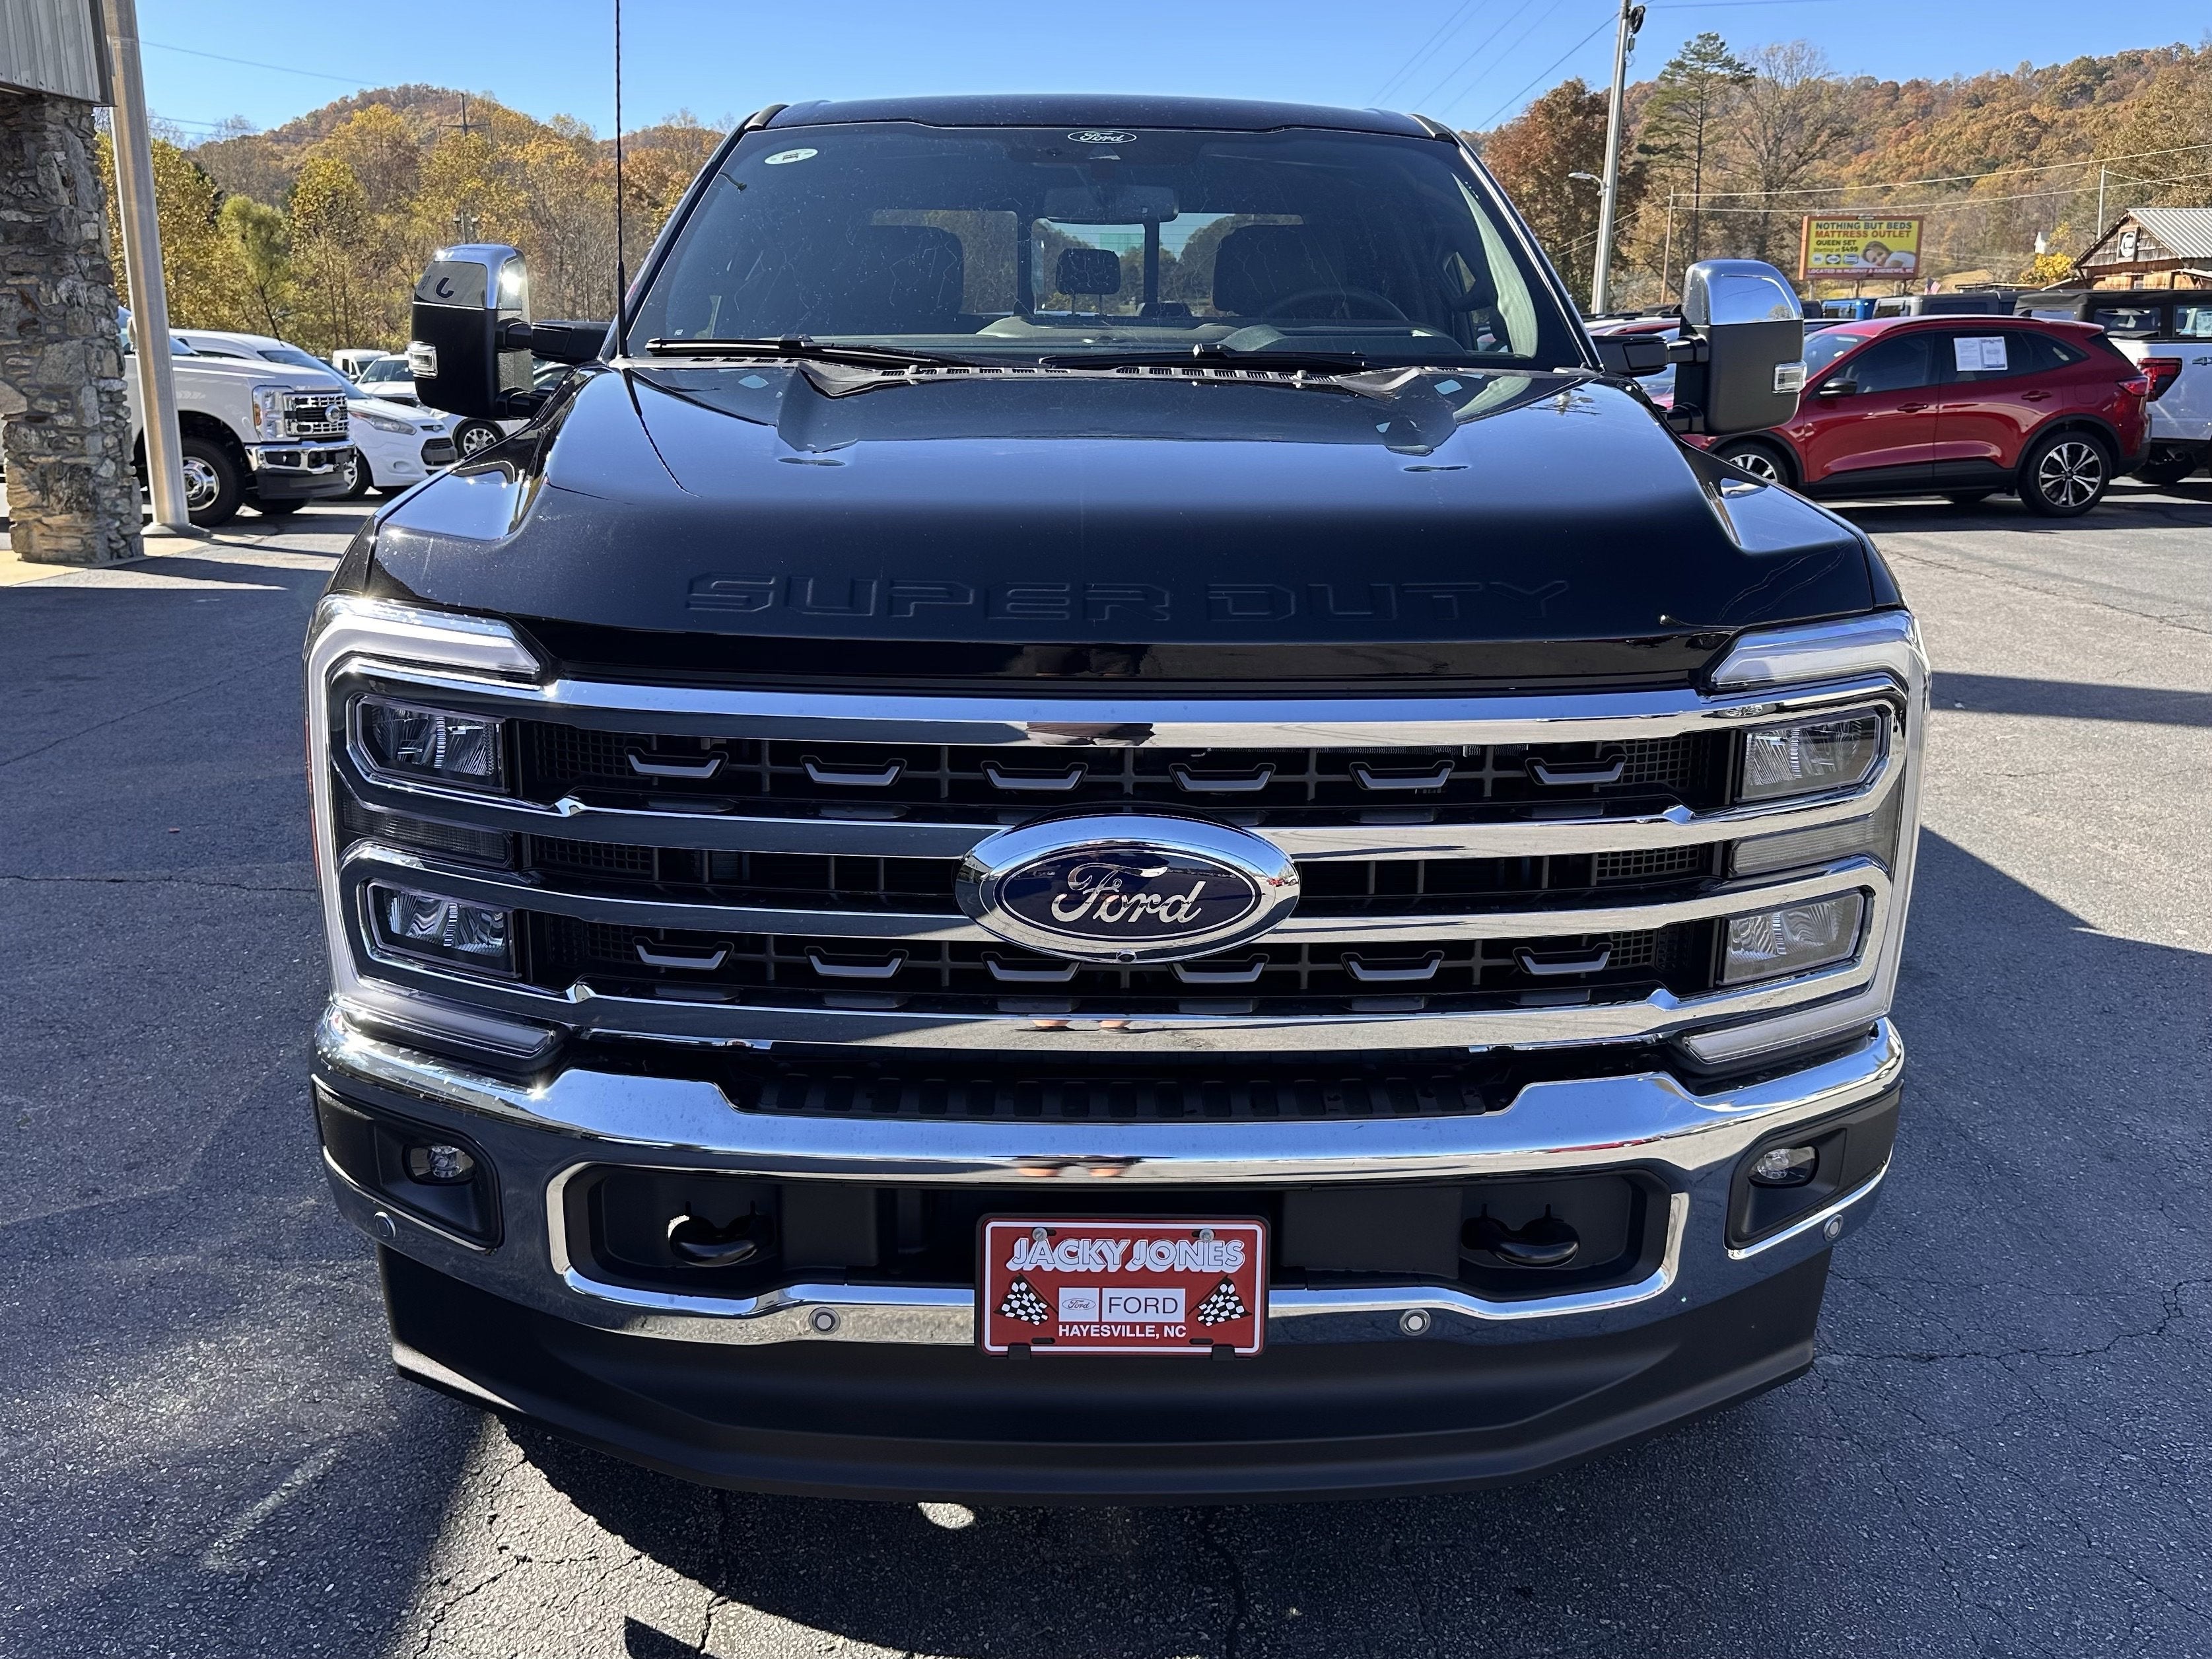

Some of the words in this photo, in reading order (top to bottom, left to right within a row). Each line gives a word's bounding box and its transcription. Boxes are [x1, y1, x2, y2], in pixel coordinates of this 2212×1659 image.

[1079, 131, 1125, 142] Ford
[685, 571, 1170, 621] SUPER
[1206, 580, 1569, 621] DUTY
[1051, 862, 1207, 923] Ford
[1006, 1238, 1130, 1272] JACKY
[1126, 1238, 1246, 1273] JONES
[1067, 1298, 1091, 1310] Ford
[1108, 1296, 1179, 1314] FORD
[1058, 1324, 1160, 1340] HAYESVILLE,
[1163, 1324, 1187, 1338] NC
